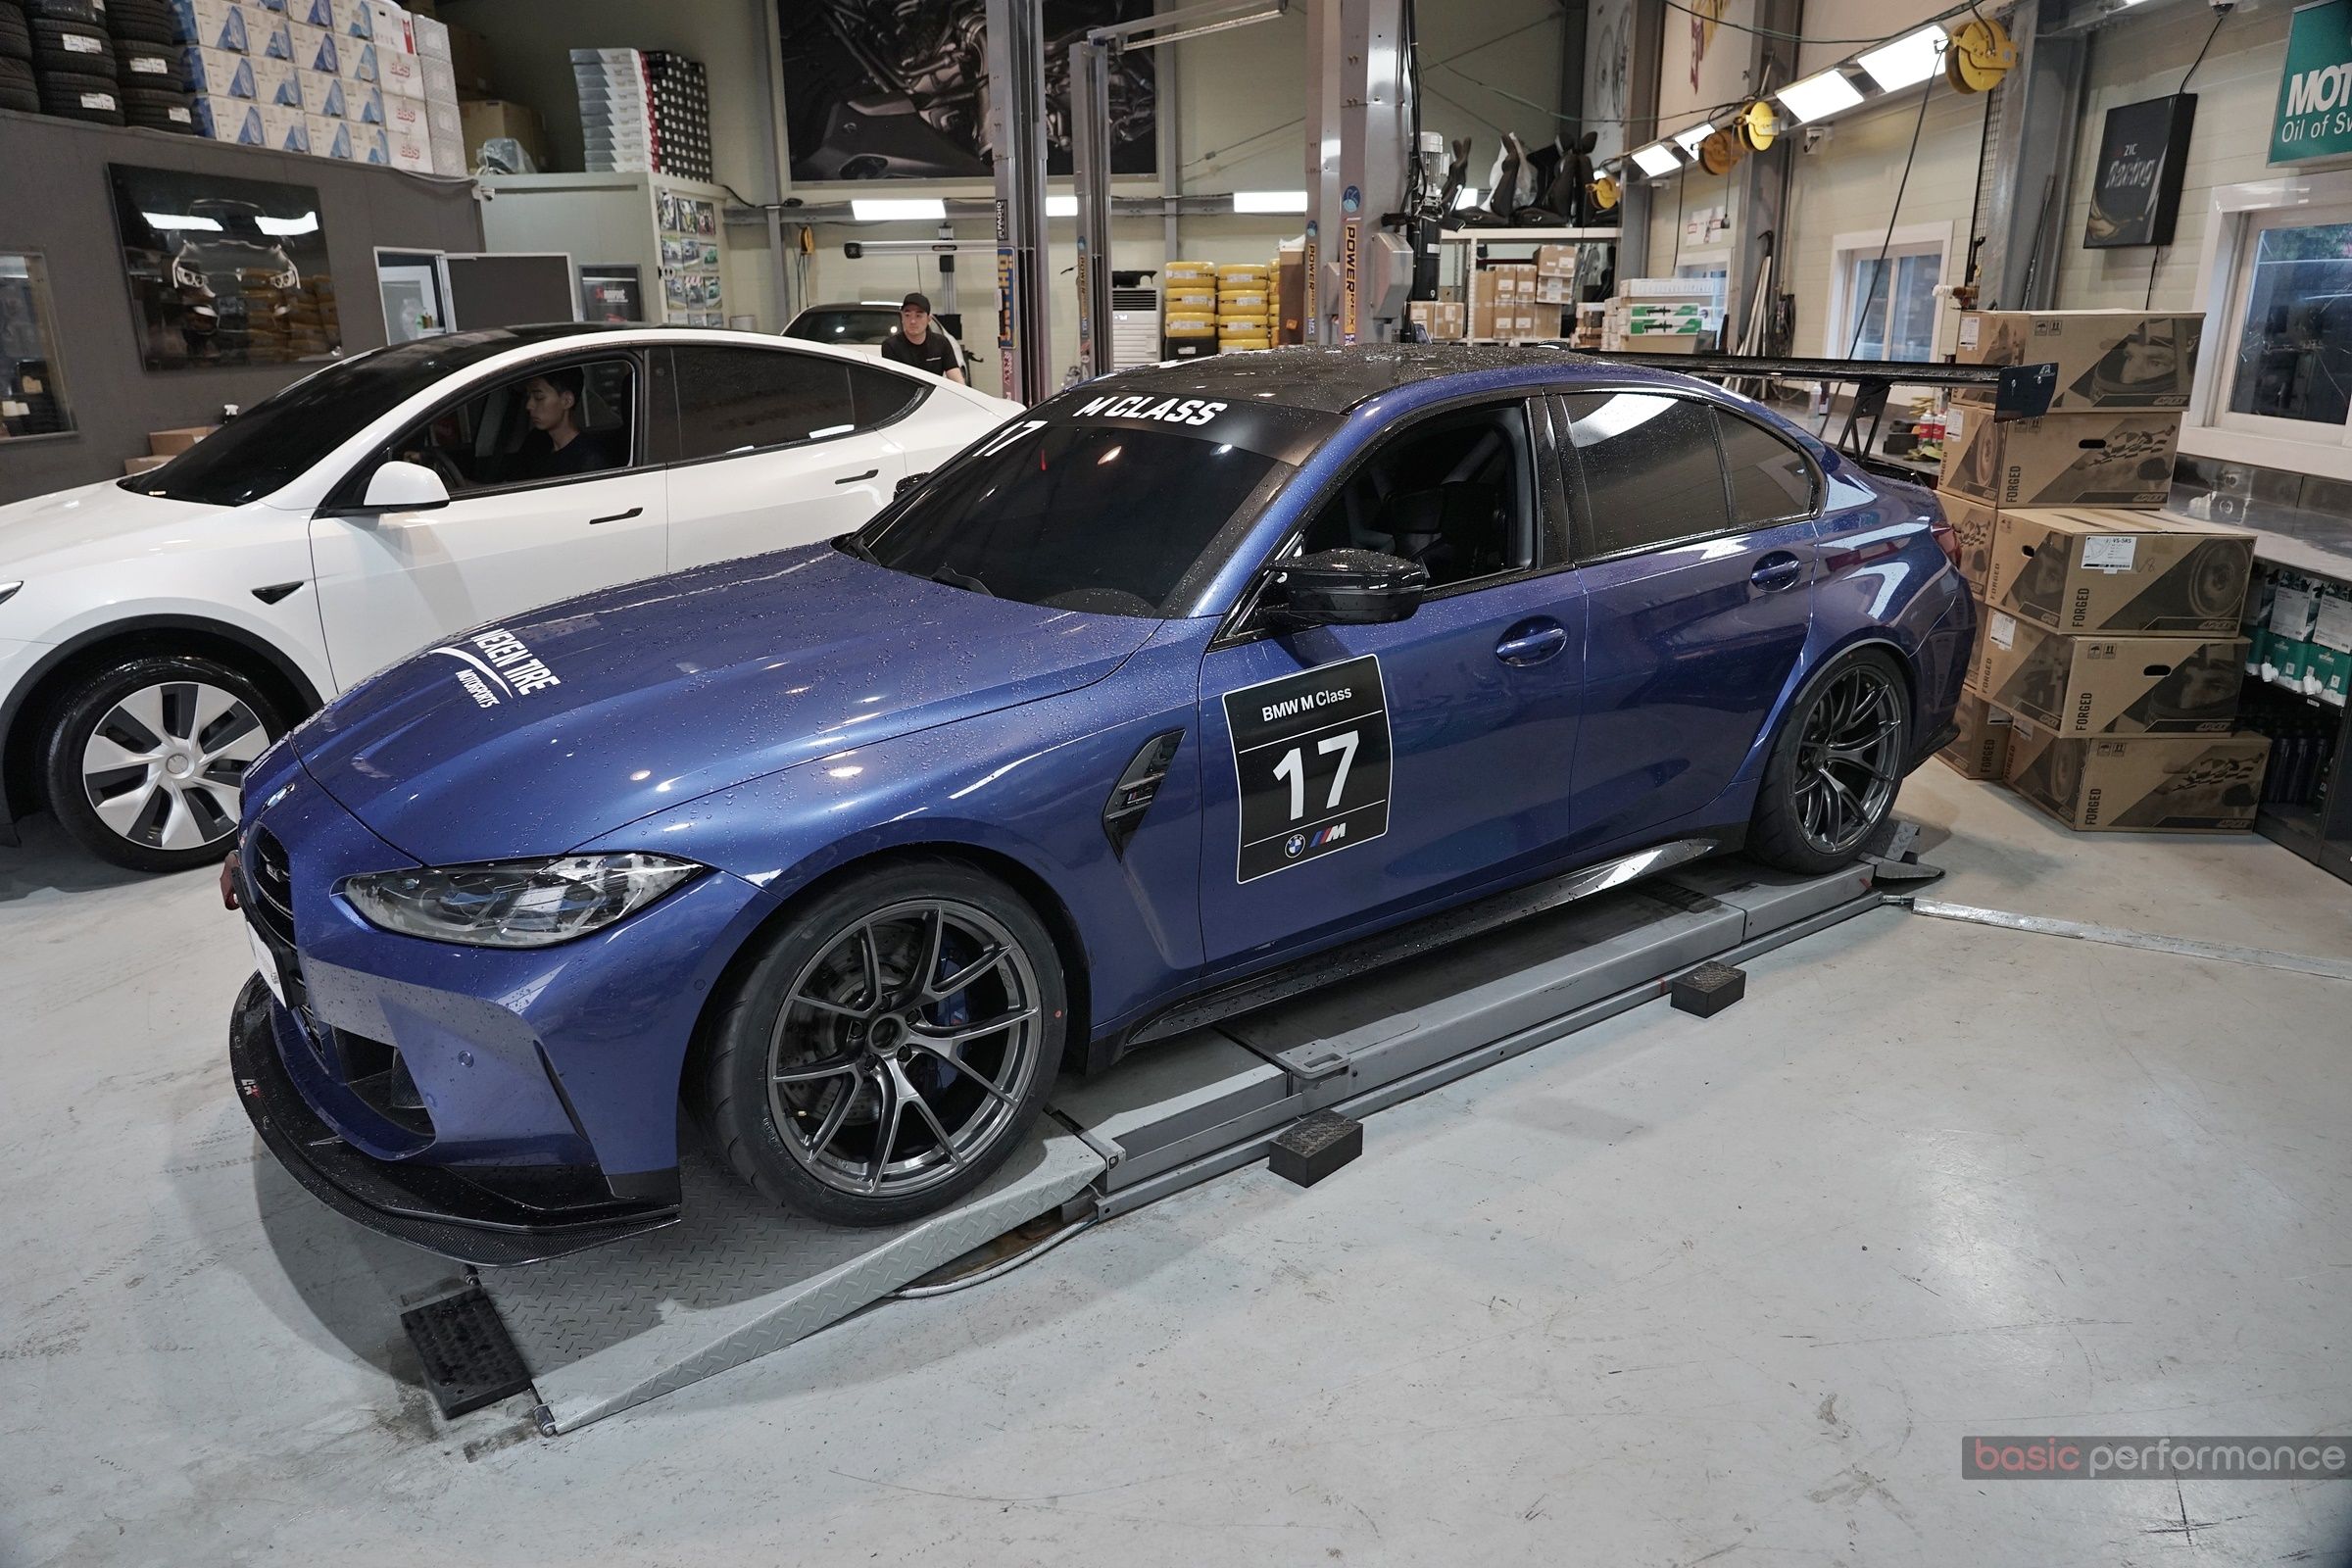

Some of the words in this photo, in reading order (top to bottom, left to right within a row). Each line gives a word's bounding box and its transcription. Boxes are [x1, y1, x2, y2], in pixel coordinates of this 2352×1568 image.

[396, 108, 416, 122] BBS
[2281, 119, 2306, 143] Oil
[2310, 114, 2330, 139] of
[2124, 143, 2138, 157] ZIC
[2105, 159, 2156, 188] Racing
[1073, 396, 1119, 417] M
[1103, 396, 1228, 425] CLASS
[972, 420, 1049, 458] 17
[2006, 466, 2022, 503] FORGED
[2073, 588, 2090, 628] FORGED
[470, 628, 533, 668] NEXEN
[503, 658, 562, 696] TIRE
[1981, 658, 1992, 694] FORGED
[455, 669, 501, 709] MOTORSPORTS
[1261, 700, 1298, 722] BMW
[1300, 694, 1315, 711] M
[1315, 687, 1352, 707] Class
[2076, 692, 2093, 731] FORGED
[1981, 739, 1995, 773] FORGED
[1272, 729, 1360, 821] 17
[2085, 788, 2102, 825] FORGED
